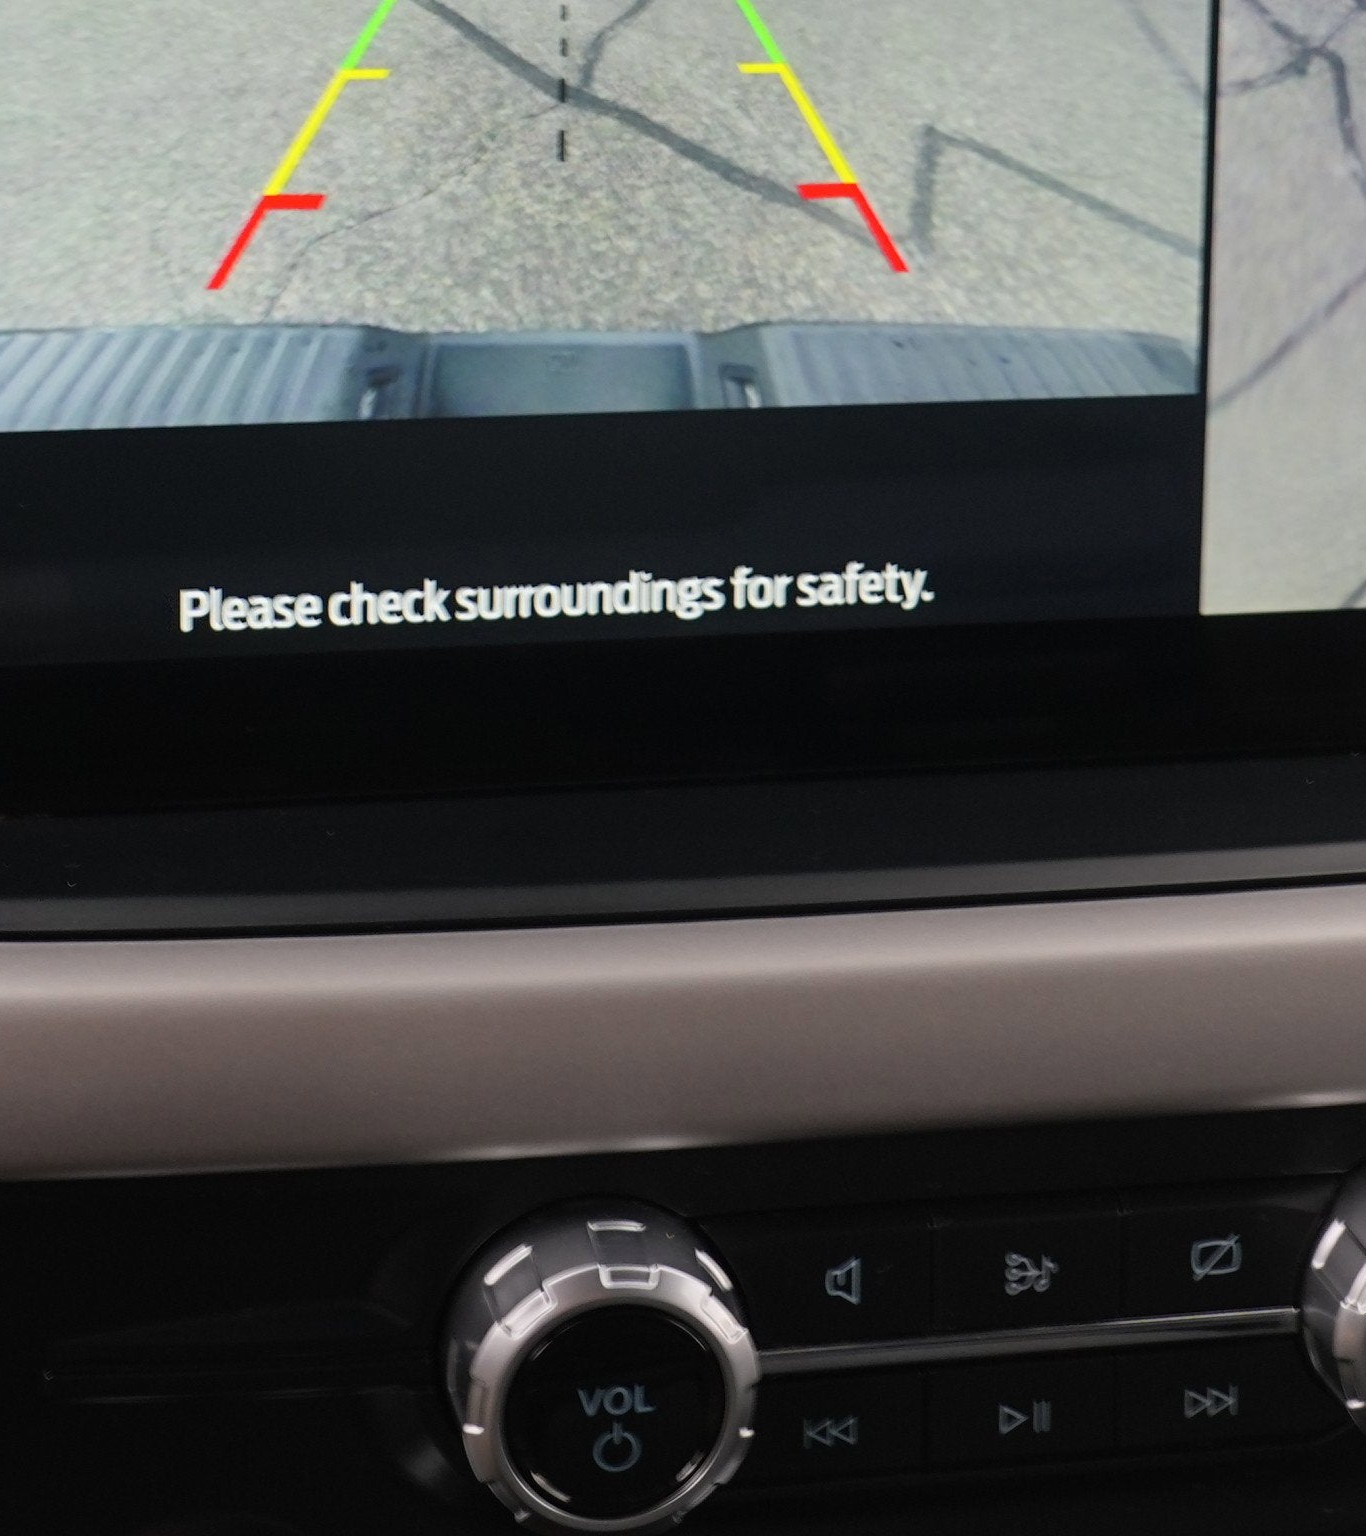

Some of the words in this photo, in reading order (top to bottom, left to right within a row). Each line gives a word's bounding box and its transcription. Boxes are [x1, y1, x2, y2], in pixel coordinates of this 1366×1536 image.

[179, 585, 323, 633] Please
[327, 577, 452, 626] check
[454, 569, 727, 621] surroundings
[730, 564, 794, 610] for
[795, 560, 936, 611] safety.
[577, 1385, 656, 1417] VOL
